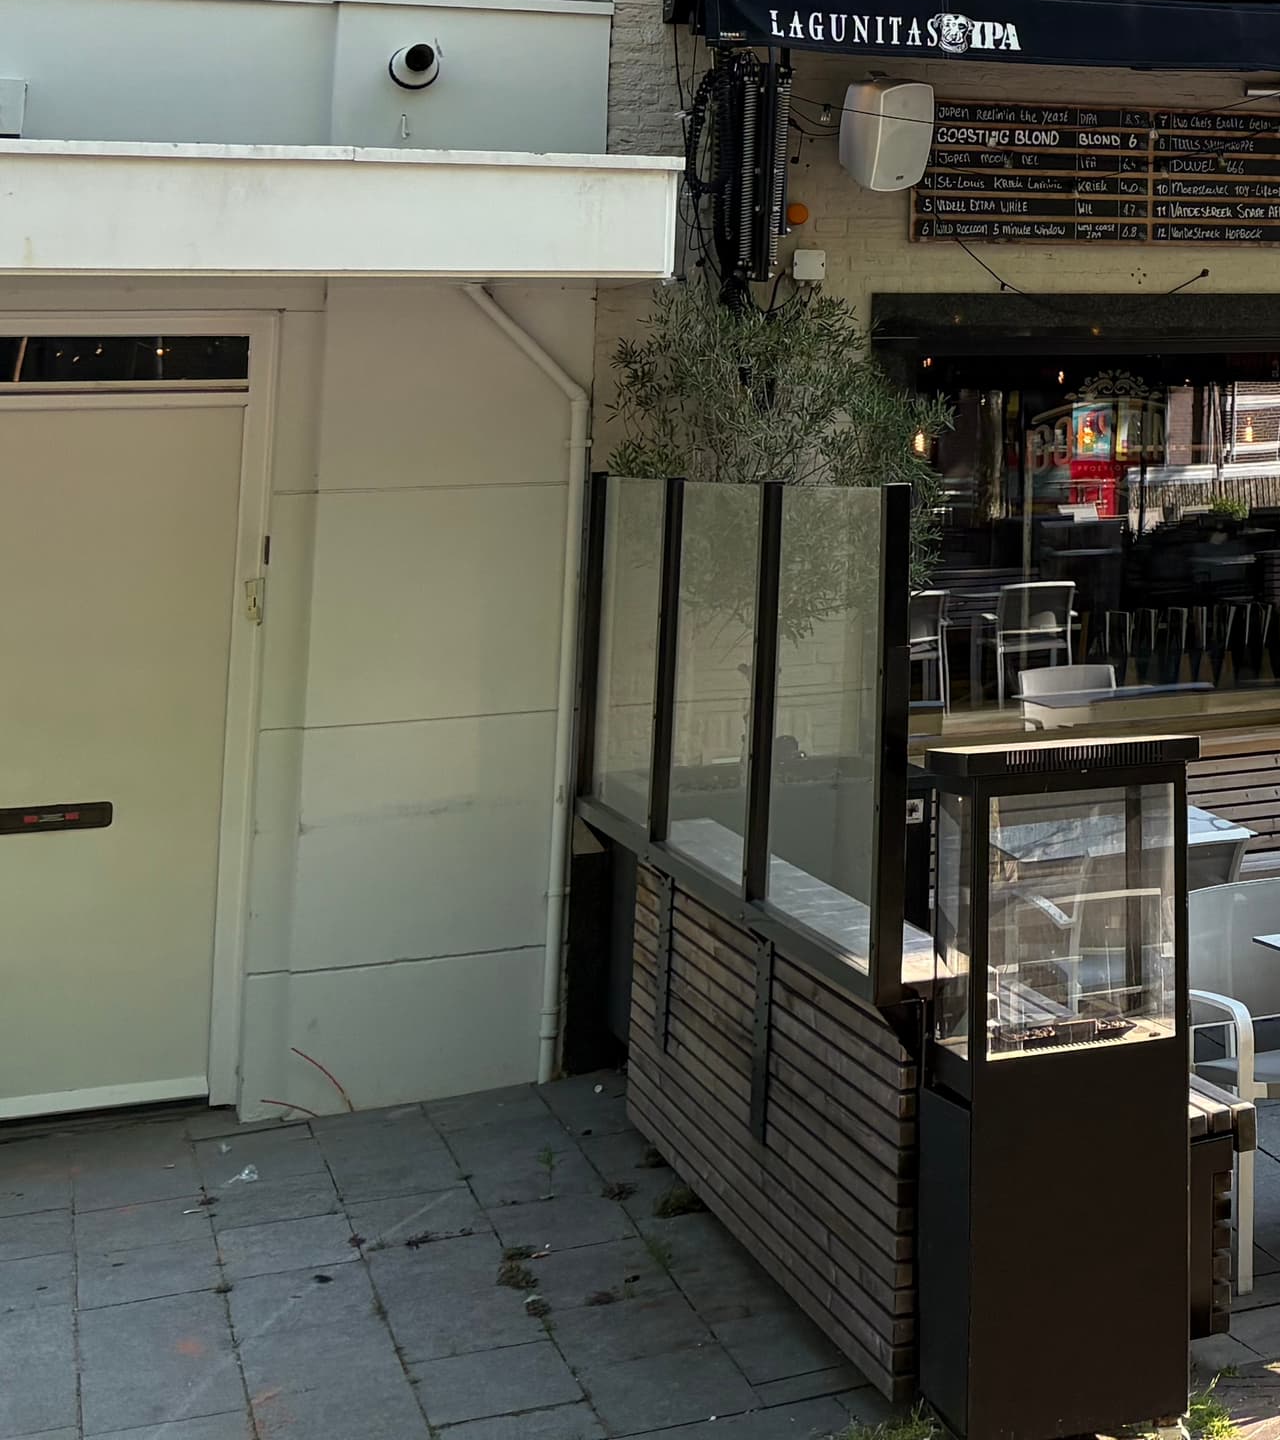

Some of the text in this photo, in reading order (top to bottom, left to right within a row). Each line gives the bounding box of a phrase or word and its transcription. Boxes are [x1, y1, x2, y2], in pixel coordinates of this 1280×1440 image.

[769, 10, 1022, 51] LAGUNITAS IPA
[1160, 116, 1168, 128] 7
[1014, 129, 1138, 148] BLOND BLOND 6
[1172, 159, 1216, 172] DUVEL
[924, 176, 932, 188] 4
[1156, 184, 1169, 196] 10
[923, 198, 932, 212] 5
[1156, 206, 1168, 218] 11
[921, 223, 930, 236] 6
[993, 224, 1000, 236] 5
[1157, 227, 1168, 239] 12
